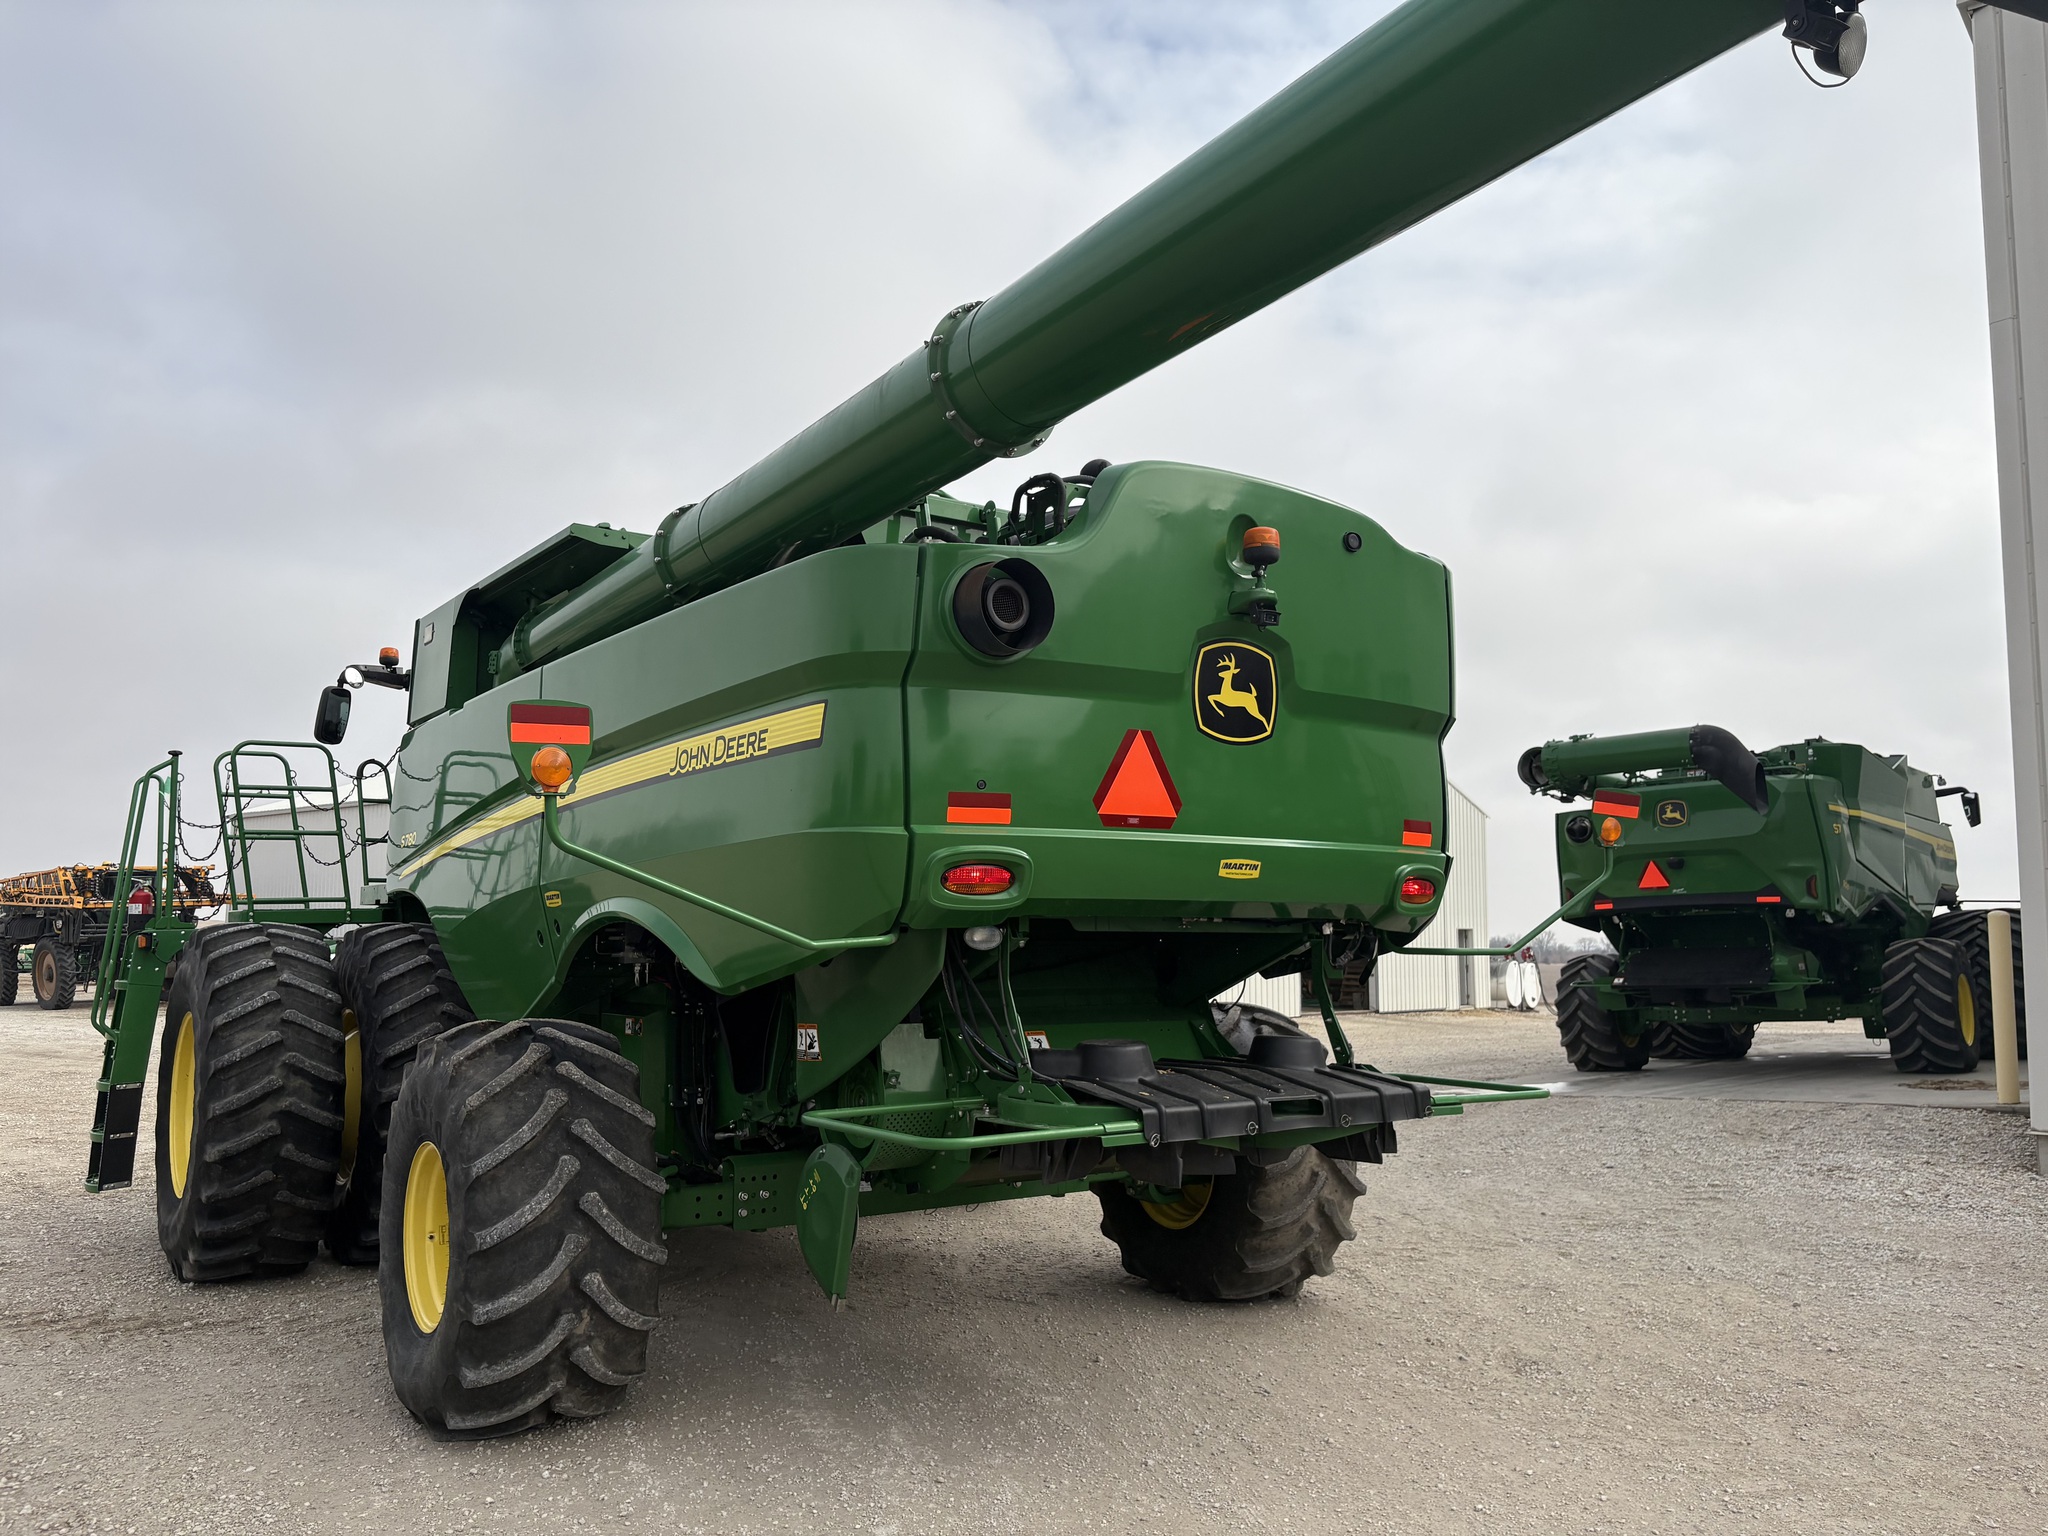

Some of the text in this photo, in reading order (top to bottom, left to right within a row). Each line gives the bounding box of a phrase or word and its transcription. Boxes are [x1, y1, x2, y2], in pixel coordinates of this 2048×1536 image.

[669, 728, 769, 773] JOHN DEERE
[1221, 862, 1260, 871] MARTIN
